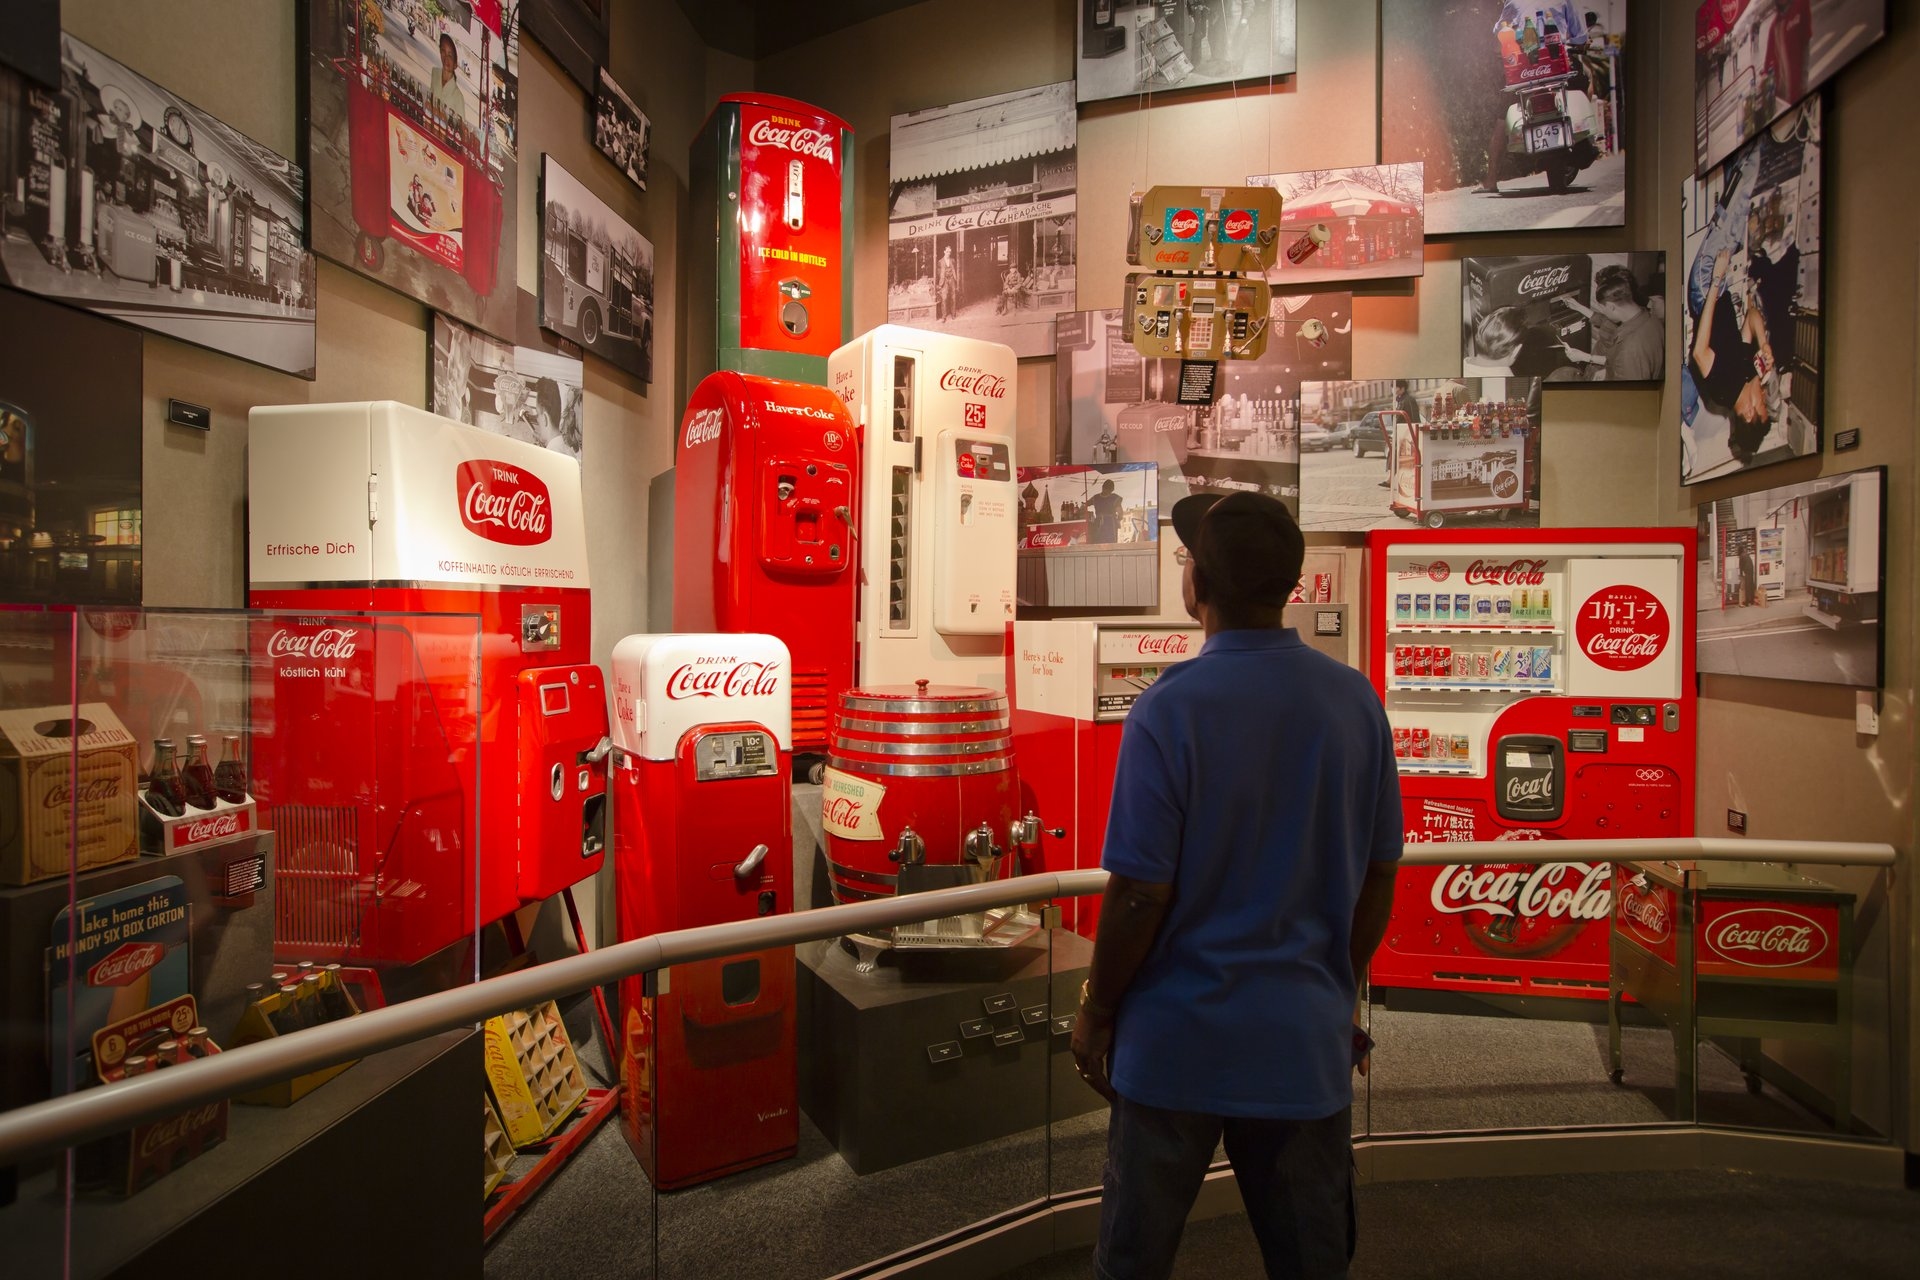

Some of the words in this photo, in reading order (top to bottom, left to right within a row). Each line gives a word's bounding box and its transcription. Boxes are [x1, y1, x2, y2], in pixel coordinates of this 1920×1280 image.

[1521, 64, 1552, 79] Coca-Cola
[771, 115, 801, 128] DRINK
[1535, 124, 1560, 139] 045
[749, 120, 834, 165] Coca-Cola
[940, 193, 982, 208] PENN
[1001, 184, 1033, 198] AVE
[909, 219, 942, 236] DRINK
[945, 215, 974, 232] Coca
[977, 207, 1008, 228] Cola
[1008, 202, 1052, 221] HEADACHE
[1172, 218, 1199, 230] Coca-Cola
[1226, 219, 1253, 231] Coca-Cola
[758, 247, 770, 258] ICE
[771, 248, 789, 260] COLD
[790, 250, 798, 262] IN
[799, 251, 827, 267] BOTTLES
[1156, 249, 1190, 263] Coca-Cola
[1518, 264, 1572, 295] Coca-Cola
[1533, 267, 1552, 275] TRINK
[836, 370, 848, 385] Have
[957, 365, 982, 374] DRINK
[940, 368, 1007, 399] Coca-Cola
[764, 400, 793, 415] Have
[804, 406, 835, 421] Coke
[966, 403, 985, 424] 25¢
[686, 407, 724, 449] Coca-Cola
[1155, 415, 1186, 433] Coca-Cola
[492, 467, 520, 485] TRINK
[465, 481, 546, 534] Coca-Cola
[266, 543, 320, 556] Erfrische
[326, 542, 355, 555] Dich
[1032, 532, 1064, 546] Coca-Cola
[438, 560, 497, 575] KOFFEINHALTIG
[500, 563, 532, 577] KÖSTLICH
[534, 567, 574, 580] ERFRISCHEND
[1465, 559, 1549, 586] Coca-Cola
[298, 616, 327, 626] TRINK
[267, 628, 358, 659] Coca-Cola
[1138, 633, 1189, 655] Coca-Cola
[1587, 633, 1660, 656] Coca-Cola
[696, 656, 738, 665] DRINK
[1023, 650, 1041, 663] Here's
[1048, 652, 1064, 664] Coke
[280, 666, 320, 678] köstlich
[324, 666, 346, 678] kühl
[666, 660, 781, 700] Coca-Cola
[1032, 664, 1042, 675] for
[1042, 665, 1053, 676] You
[617, 678, 628, 693] Have
[617, 697, 634, 722] Coke
[20, 738, 50, 753] SAVE
[81, 729, 129, 745] CARTON
[746, 737, 760, 746] 10¢
[833, 780, 865, 797] REFRESHED
[1424, 799, 1455, 810] Refreshment
[1456, 804, 1474, 813] Inside!
[188, 814, 237, 842] Coca-Cola
[1431, 862, 1611, 920] Coca-Cola
[72, 901, 108, 934] Take
[112, 905, 144, 923] home
[148, 895, 169, 912] this
[1624, 893, 1664, 934] Coca-Cola
[104, 927, 121, 944] SIX
[123, 918, 145, 938] BOX
[147, 906, 184, 928] CARTON
[1717, 923, 1812, 953] Coca-Cola
[94, 945, 158, 985] Coca-Cola
[124, 1024, 138, 1037] FOR
[139, 1019, 152, 1030] THE
[152, 1010, 171, 1025] HOME
[108, 1038, 117, 1051] 6
[757, 1107, 788, 1123] Vendo
[141, 1103, 220, 1158] Coca-Cola
